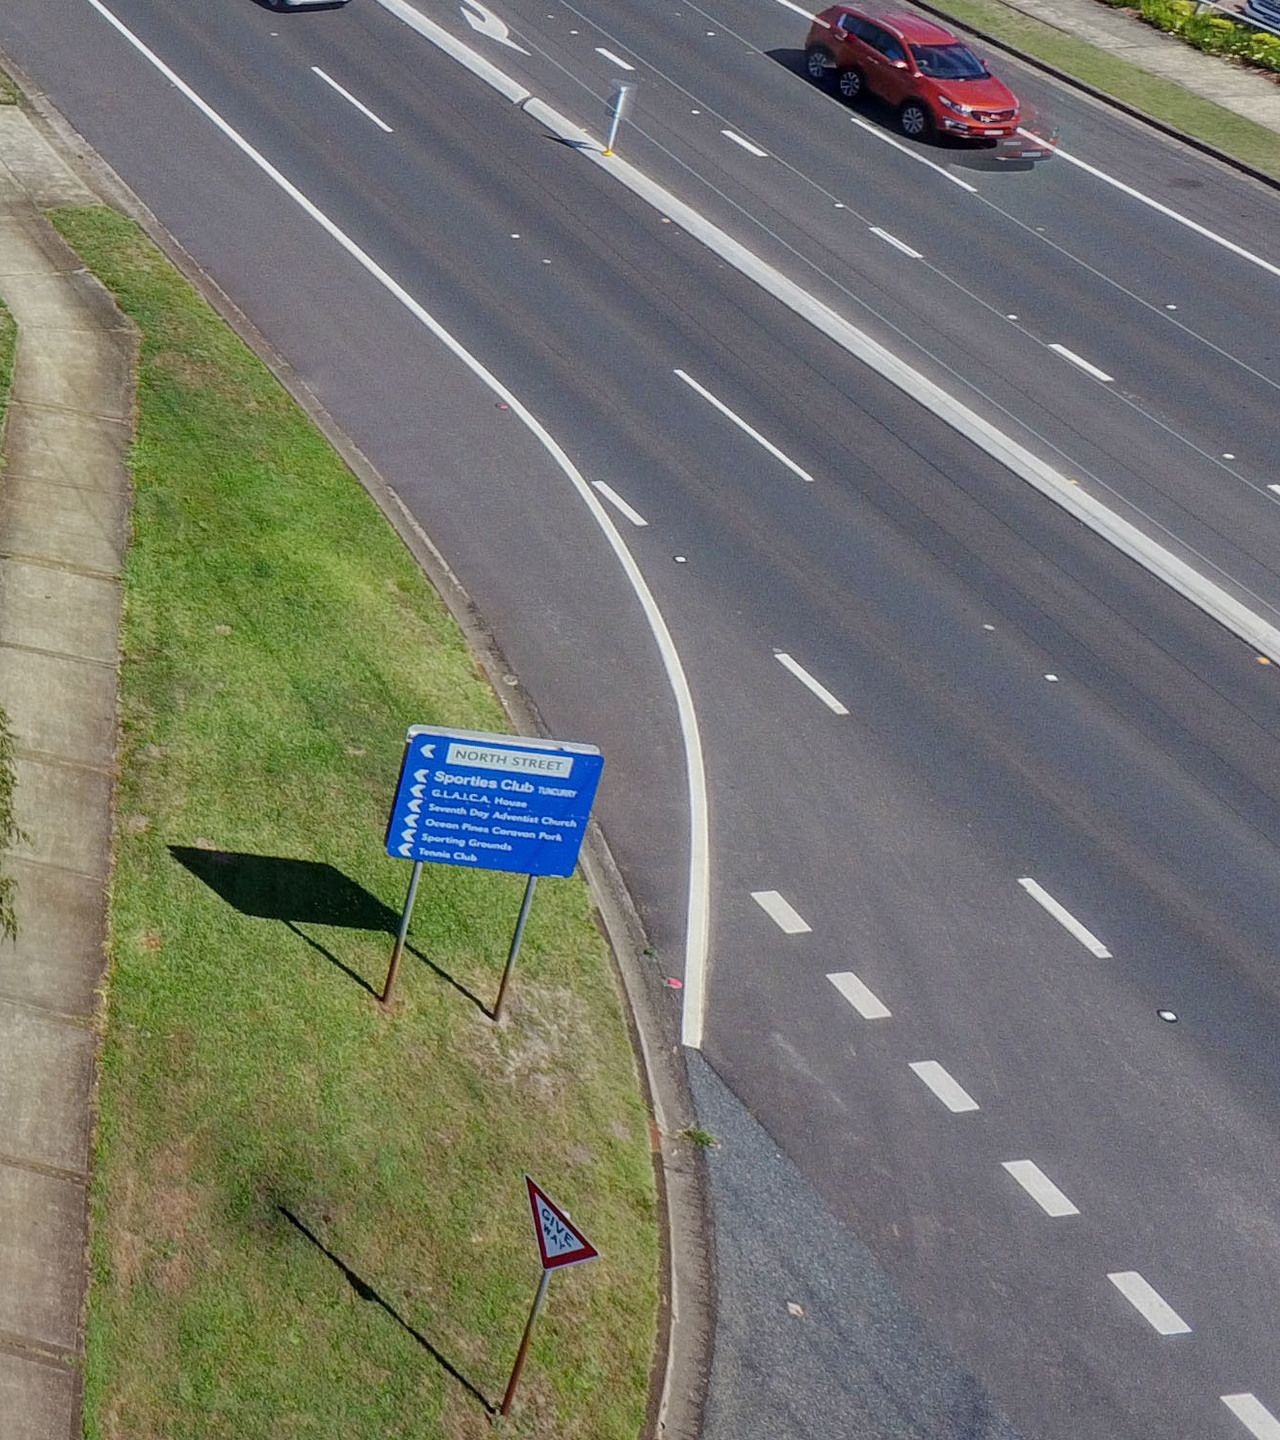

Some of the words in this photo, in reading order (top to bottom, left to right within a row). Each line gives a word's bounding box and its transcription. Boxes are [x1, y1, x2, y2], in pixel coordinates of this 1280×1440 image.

[455, 750, 507, 764] NORTH
[511, 757, 564, 771] STREET
[434, 771, 498, 789] Sporties
[501, 779, 535, 793] Club
[494, 797, 528, 808] House
[428, 803, 467, 815] Seventh
[469, 808, 490, 819] Day
[492, 811, 539, 824] Adventist
[541, 816, 577, 828] Church
[425, 818, 459, 830] Ocean
[462, 822, 489, 833] Pines
[492, 826, 536, 839] Caravan
[538, 831, 562, 842] Park
[421, 833, 466, 847] Sporting
[468, 839, 513, 851] Grounds
[418, 847, 451, 859] Tennis
[453, 851, 478, 862] Club
[541, 1208, 574, 1248] GIVE
